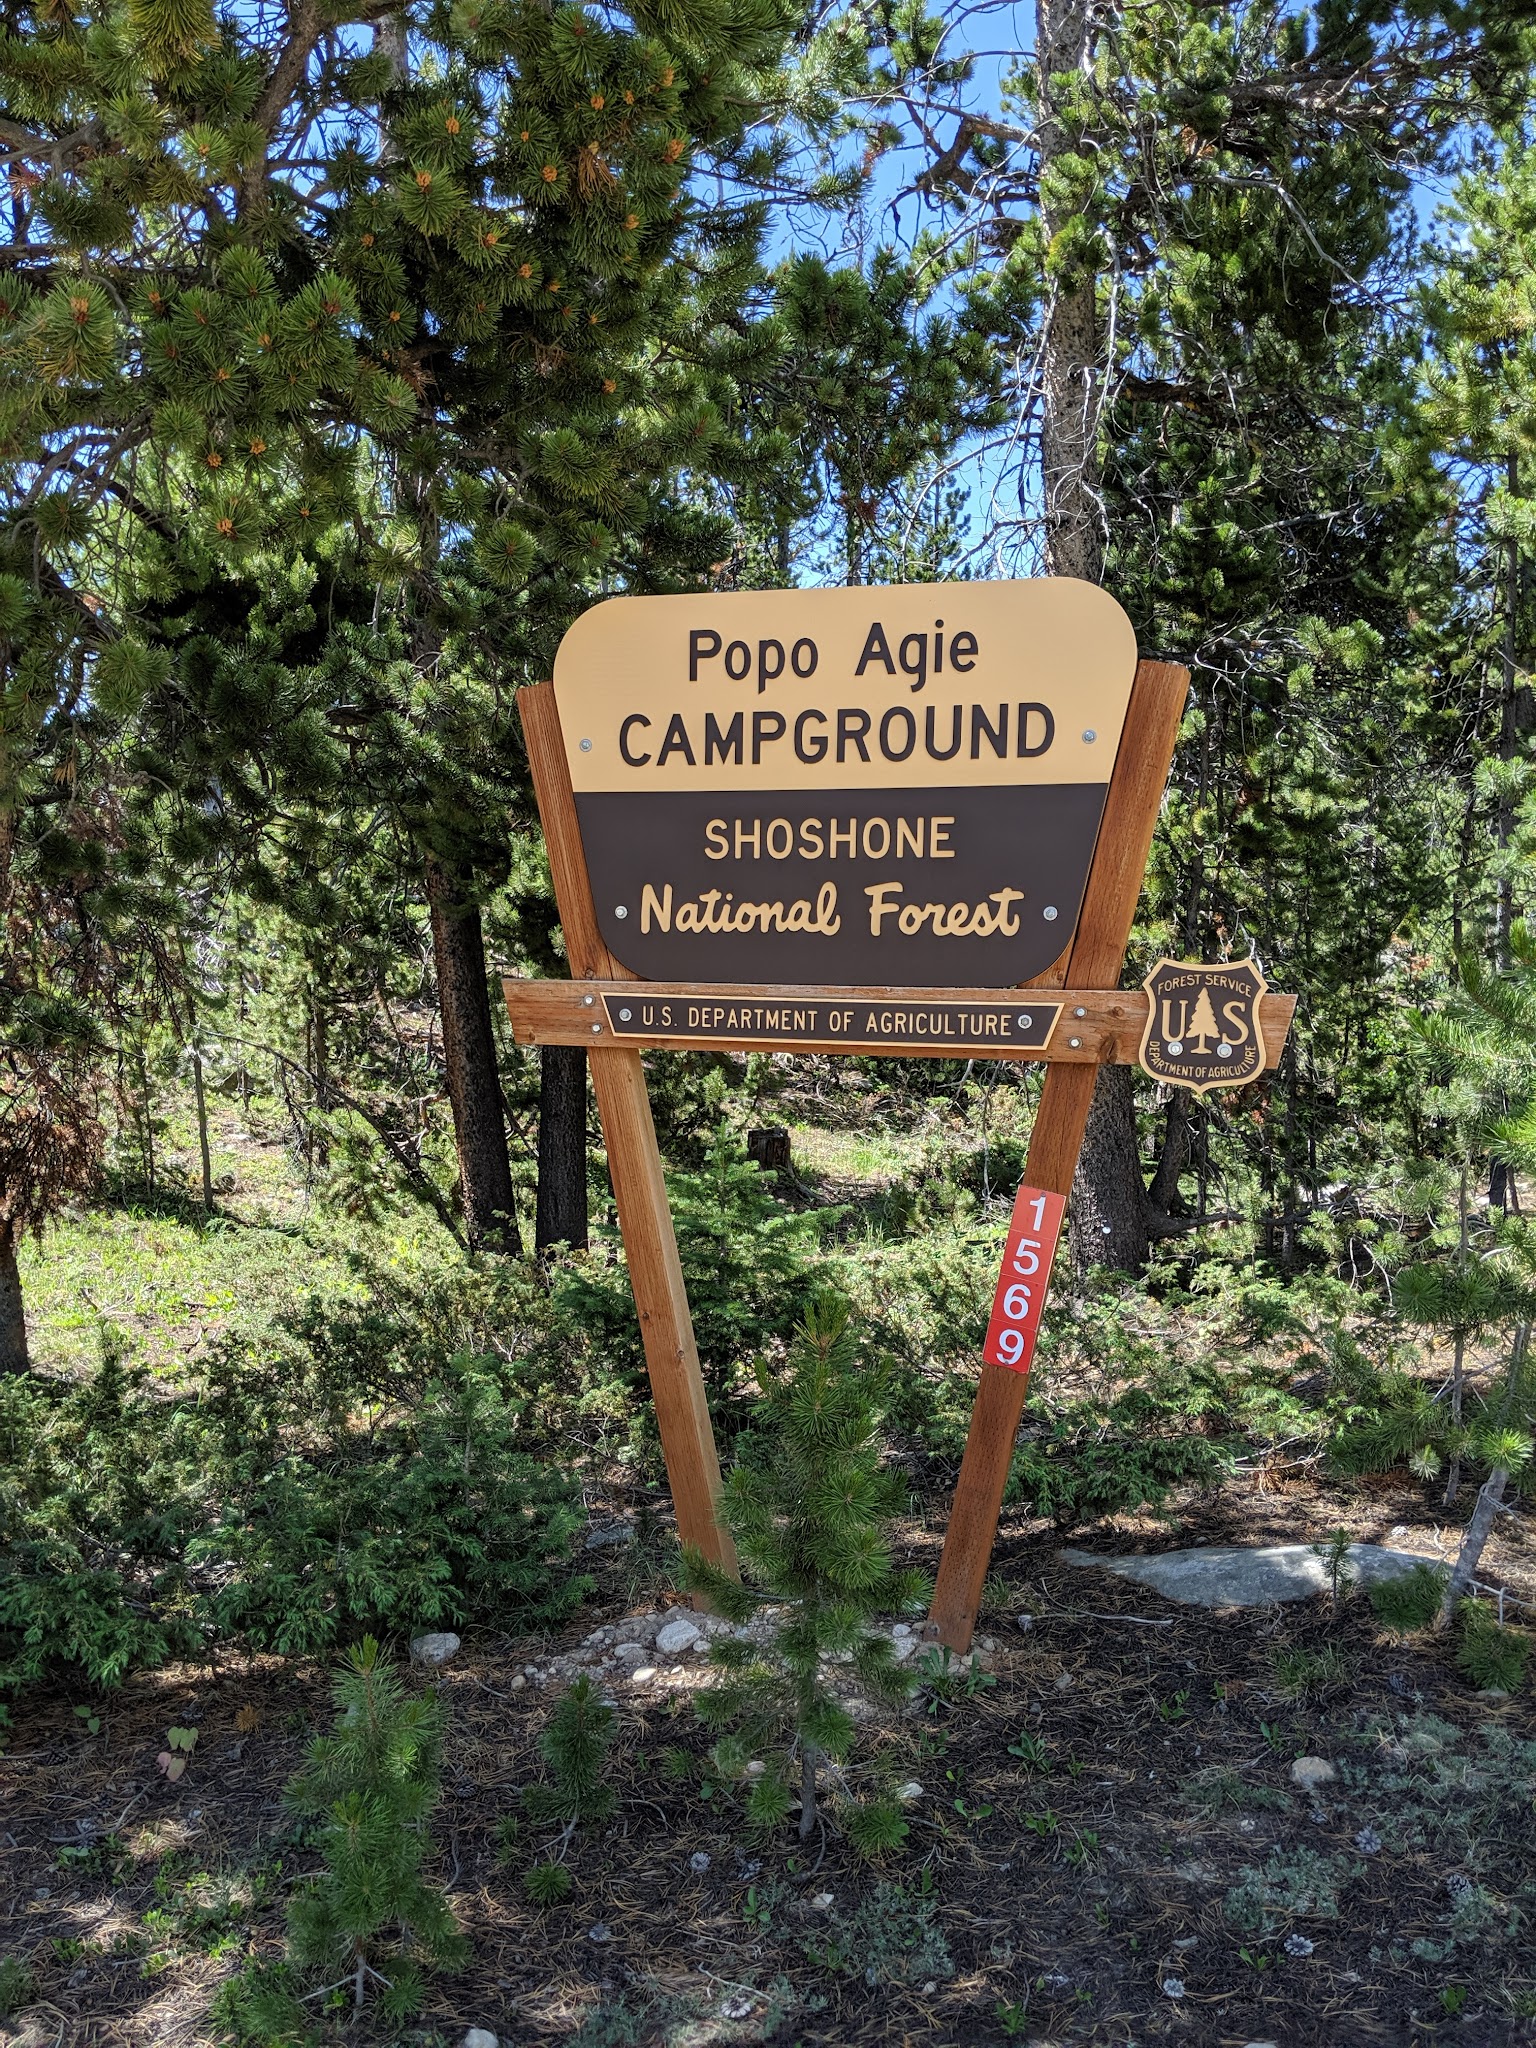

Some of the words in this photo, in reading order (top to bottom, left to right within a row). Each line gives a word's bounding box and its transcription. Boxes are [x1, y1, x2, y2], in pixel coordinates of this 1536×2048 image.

[688, 628, 820, 695] Popo
[854, 618, 980, 692] Agie
[618, 701, 1055, 768] CAMPGROUND
[704, 815, 956, 861] SHOSHONE
[639, 880, 841, 937] National
[863, 880, 1025, 937] Forest
[1158, 974, 1202, 995] FOREST
[1205, 974, 1252, 997] SERVICE
[641, 1005, 678, 1028] U.S.
[687, 1006, 818, 1032] DEPARTMENT
[828, 1010, 855, 1032] OF
[865, 1011, 1012, 1036] AGRICULTURE
[1148, 1041, 1194, 1077] DEPARTMENT
[1195, 1066, 1207, 1077] OF
[1207, 1044, 1256, 1078] AGRICULTURE
[995, 1194, 1046, 1366] 1569
